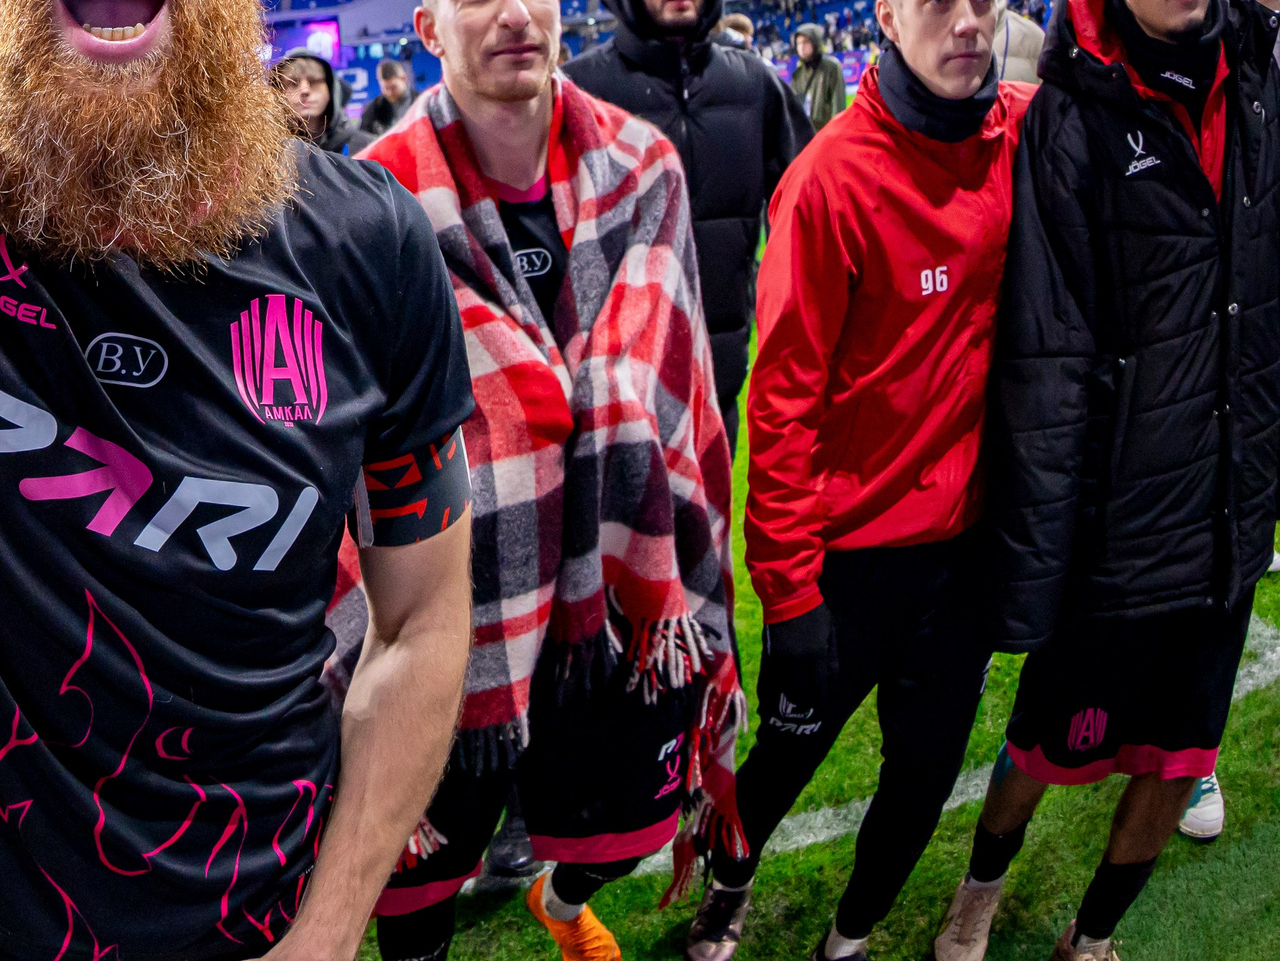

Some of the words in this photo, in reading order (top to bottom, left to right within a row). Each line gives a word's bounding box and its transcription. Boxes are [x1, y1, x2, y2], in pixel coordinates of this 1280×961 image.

[1125, 156, 1161, 176] JÖGEL
[920, 265, 949, 296] 96
[264, 405, 313, 421] АМКАЛ
